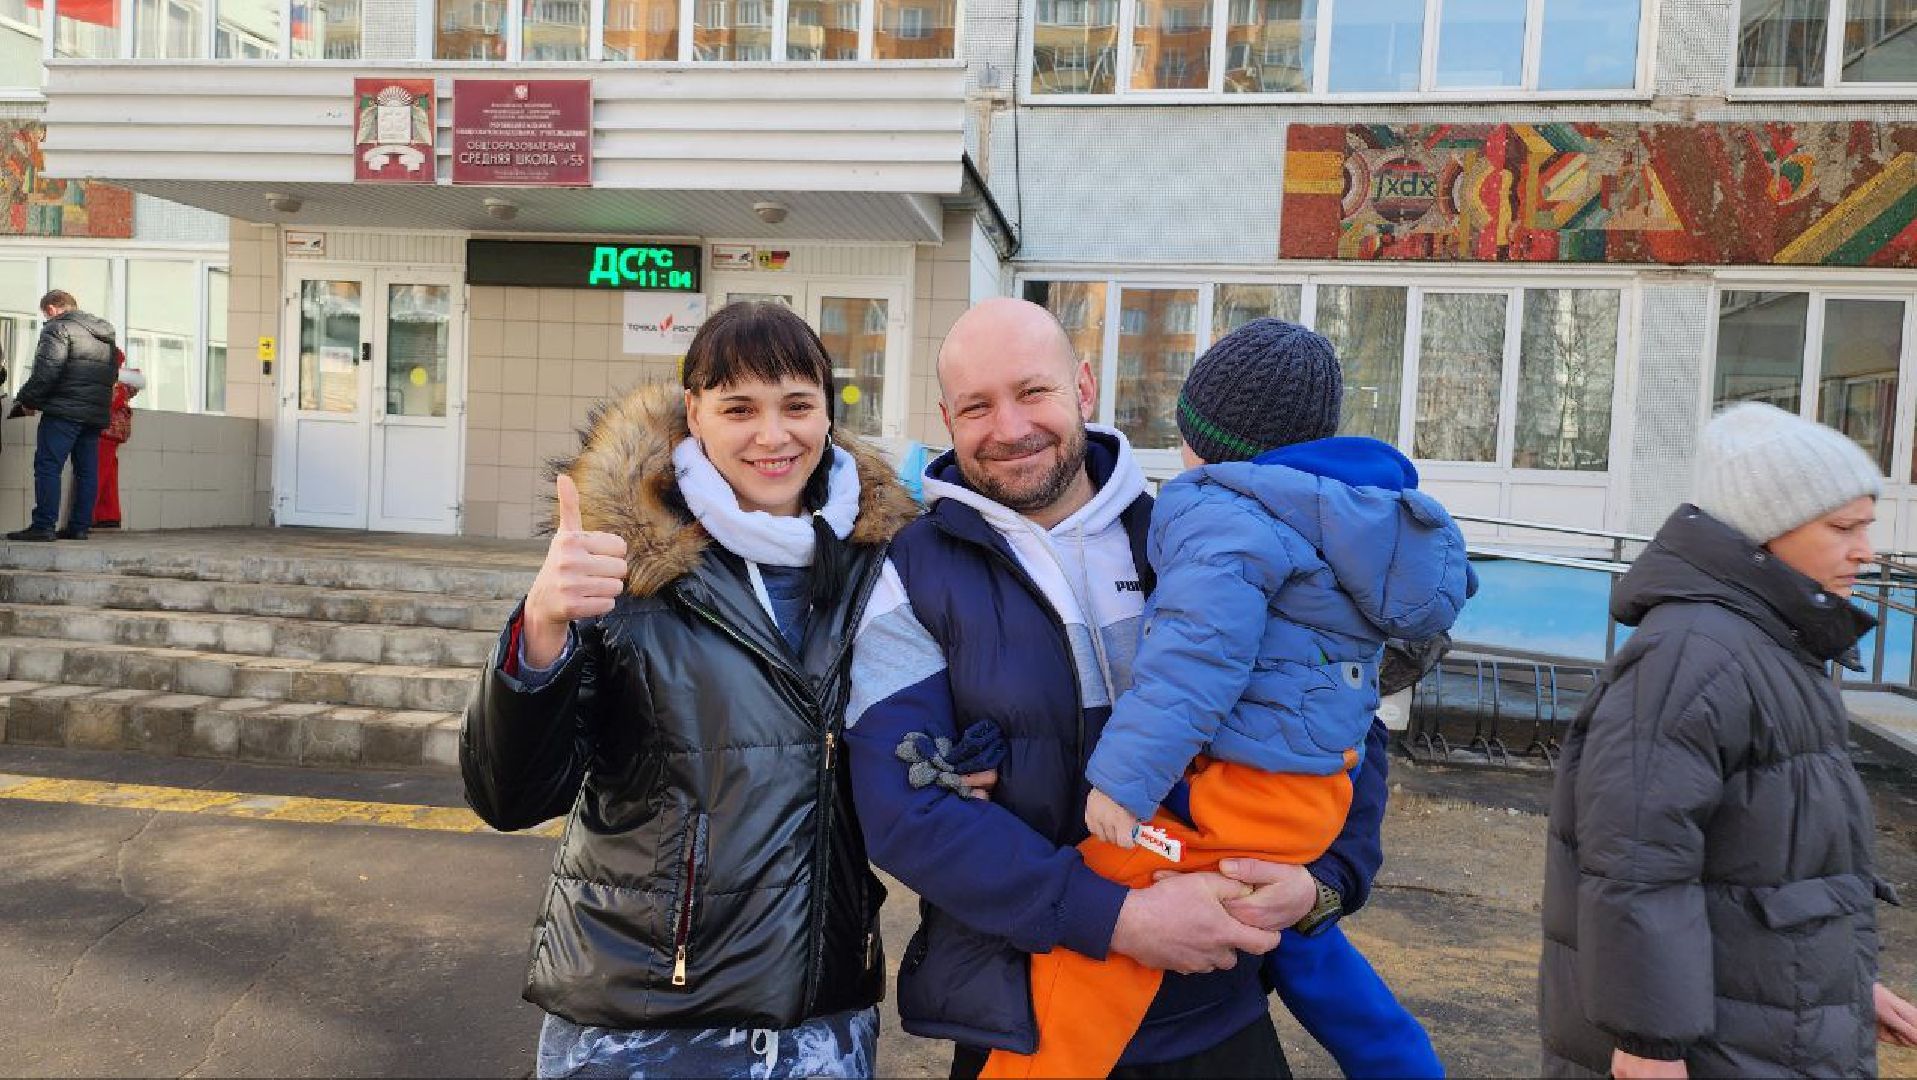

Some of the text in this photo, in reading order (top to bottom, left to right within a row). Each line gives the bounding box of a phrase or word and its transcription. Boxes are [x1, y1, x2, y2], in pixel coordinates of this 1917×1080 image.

[466, 141, 577, 152] ОБЩЕОБРАЗОВАТЕЛЬНАЯ
[459, 153, 512, 166] СРЕДНЯЯ
[515, 154, 559, 166] ШКОЛА
[639, 270, 691, 288] 11:04
[628, 323, 658, 332] ТОЧКА
[1114, 580, 1142, 592] PUM
